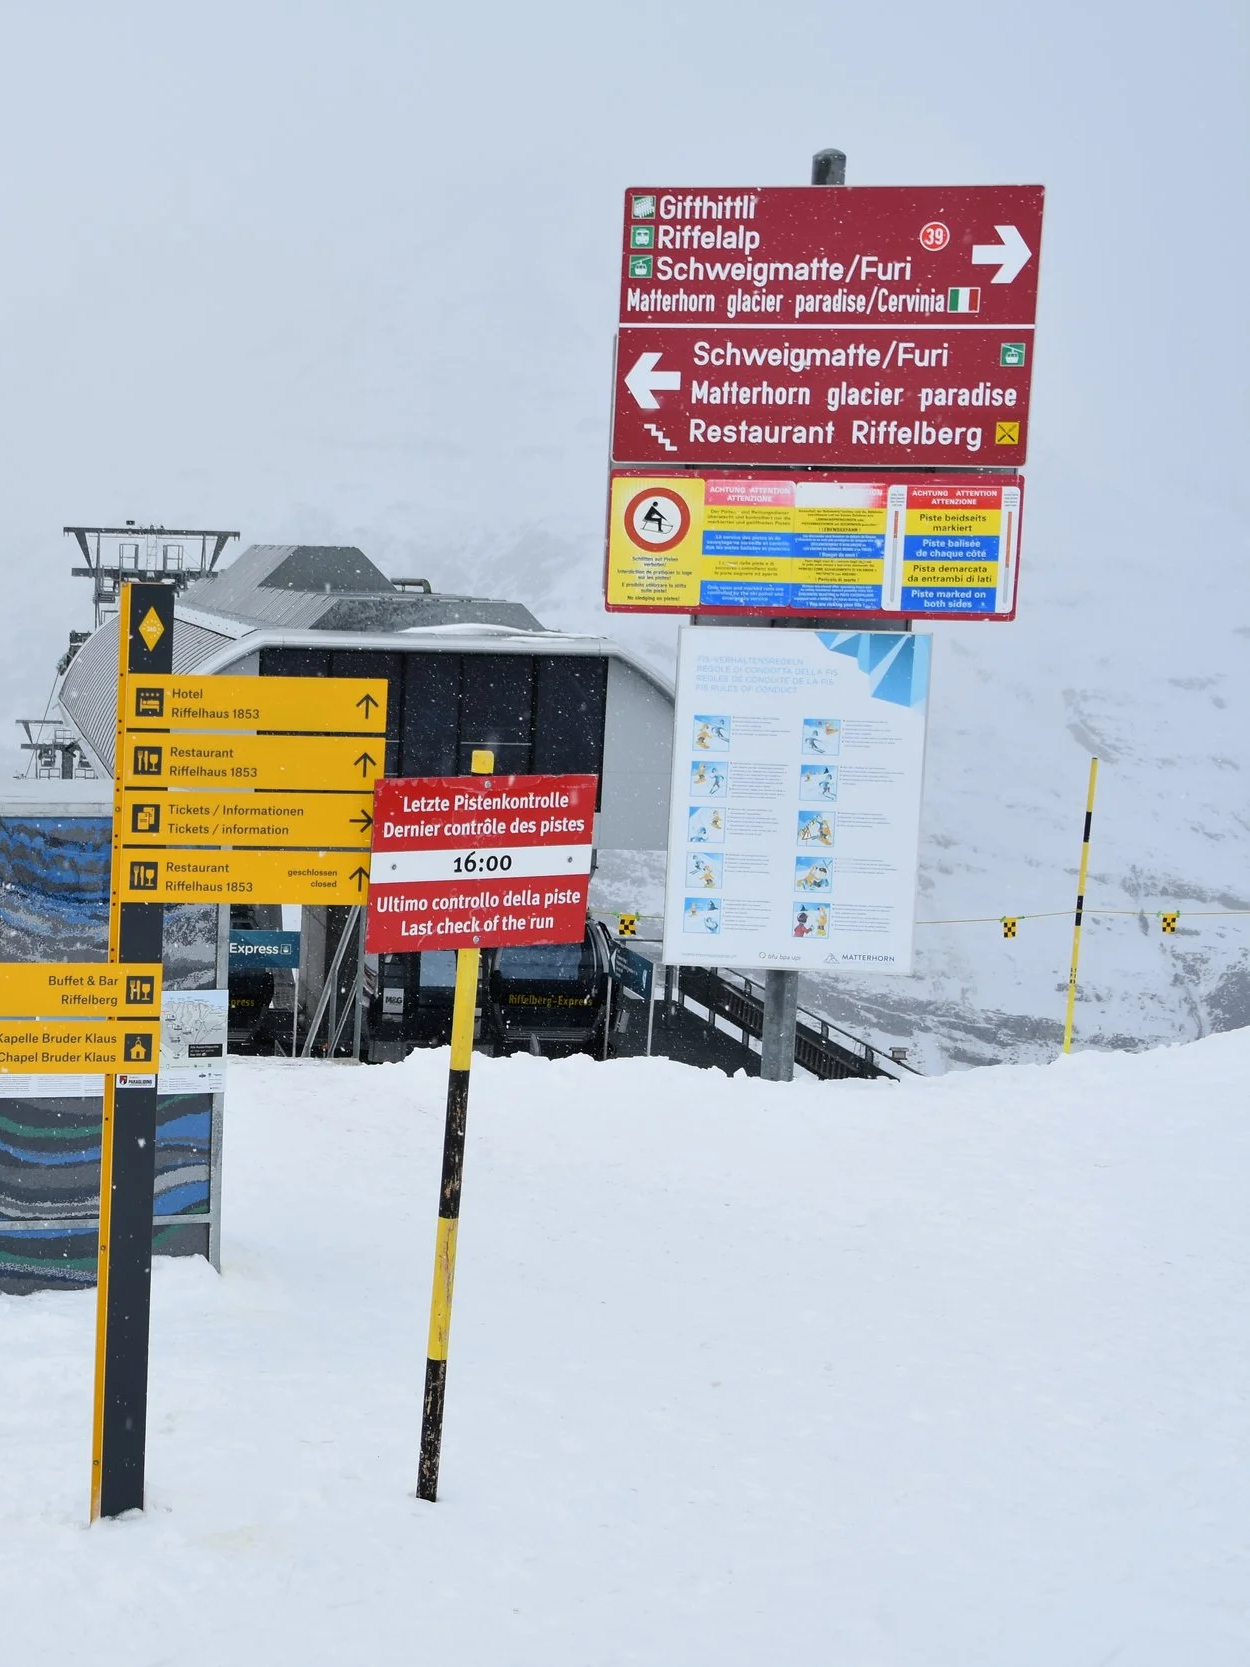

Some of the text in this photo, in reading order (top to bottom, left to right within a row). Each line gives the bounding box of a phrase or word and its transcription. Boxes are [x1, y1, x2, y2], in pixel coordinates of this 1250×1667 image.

[659, 195, 756, 220] Gifthittli
[658, 225, 760, 255] Riffelalp
[924, 229, 944, 245] 39
[657, 255, 912, 286] Schweigmatte/Furi
[627, 288, 944, 318] Matterhorn glacier paradise/Cervinia
[693, 342, 948, 372] Schweigmatte/Furi
[691, 381, 1017, 411] Matterhorn glacier paradise
[689, 420, 982, 451] Restaurant Riffelberg
[948, 538, 980, 548] balisée
[930, 550, 964, 558] chaque
[966, 548, 986, 557] côté
[172, 689, 202, 699] Hotel
[172, 708, 259, 719] Riffelhaus 1853
[170, 747, 233, 758] Restaurant
[170, 767, 257, 778] Riffelhaus 1853
[403, 792, 568, 812] Letzte Pistenkontrolle
[169, 804, 304, 817] Tickets / Informationen
[168, 824, 289, 835] Tickets / information
[384, 817, 584, 838] Dernier contrôle des pistes
[454, 851, 512, 872] 16:00
[166, 863, 229, 873] Restaurant
[288, 868, 337, 877] geschlossen
[166, 881, 253, 892] Riffelhaus 1853
[377, 889, 580, 912] Ultimo controllo della piste
[401, 914, 553, 936] Last check of the run
[230, 943, 278, 955] Express
[49, 976, 118, 986] Buffet & Bar
[62, 995, 118, 1006] Riffelberg
[42, 1034, 82, 1043] Bruder
[85, 1034, 116, 1043] Klaus
[42, 1053, 81, 1062] Bruder
[85, 1053, 116, 1062] Klaus
